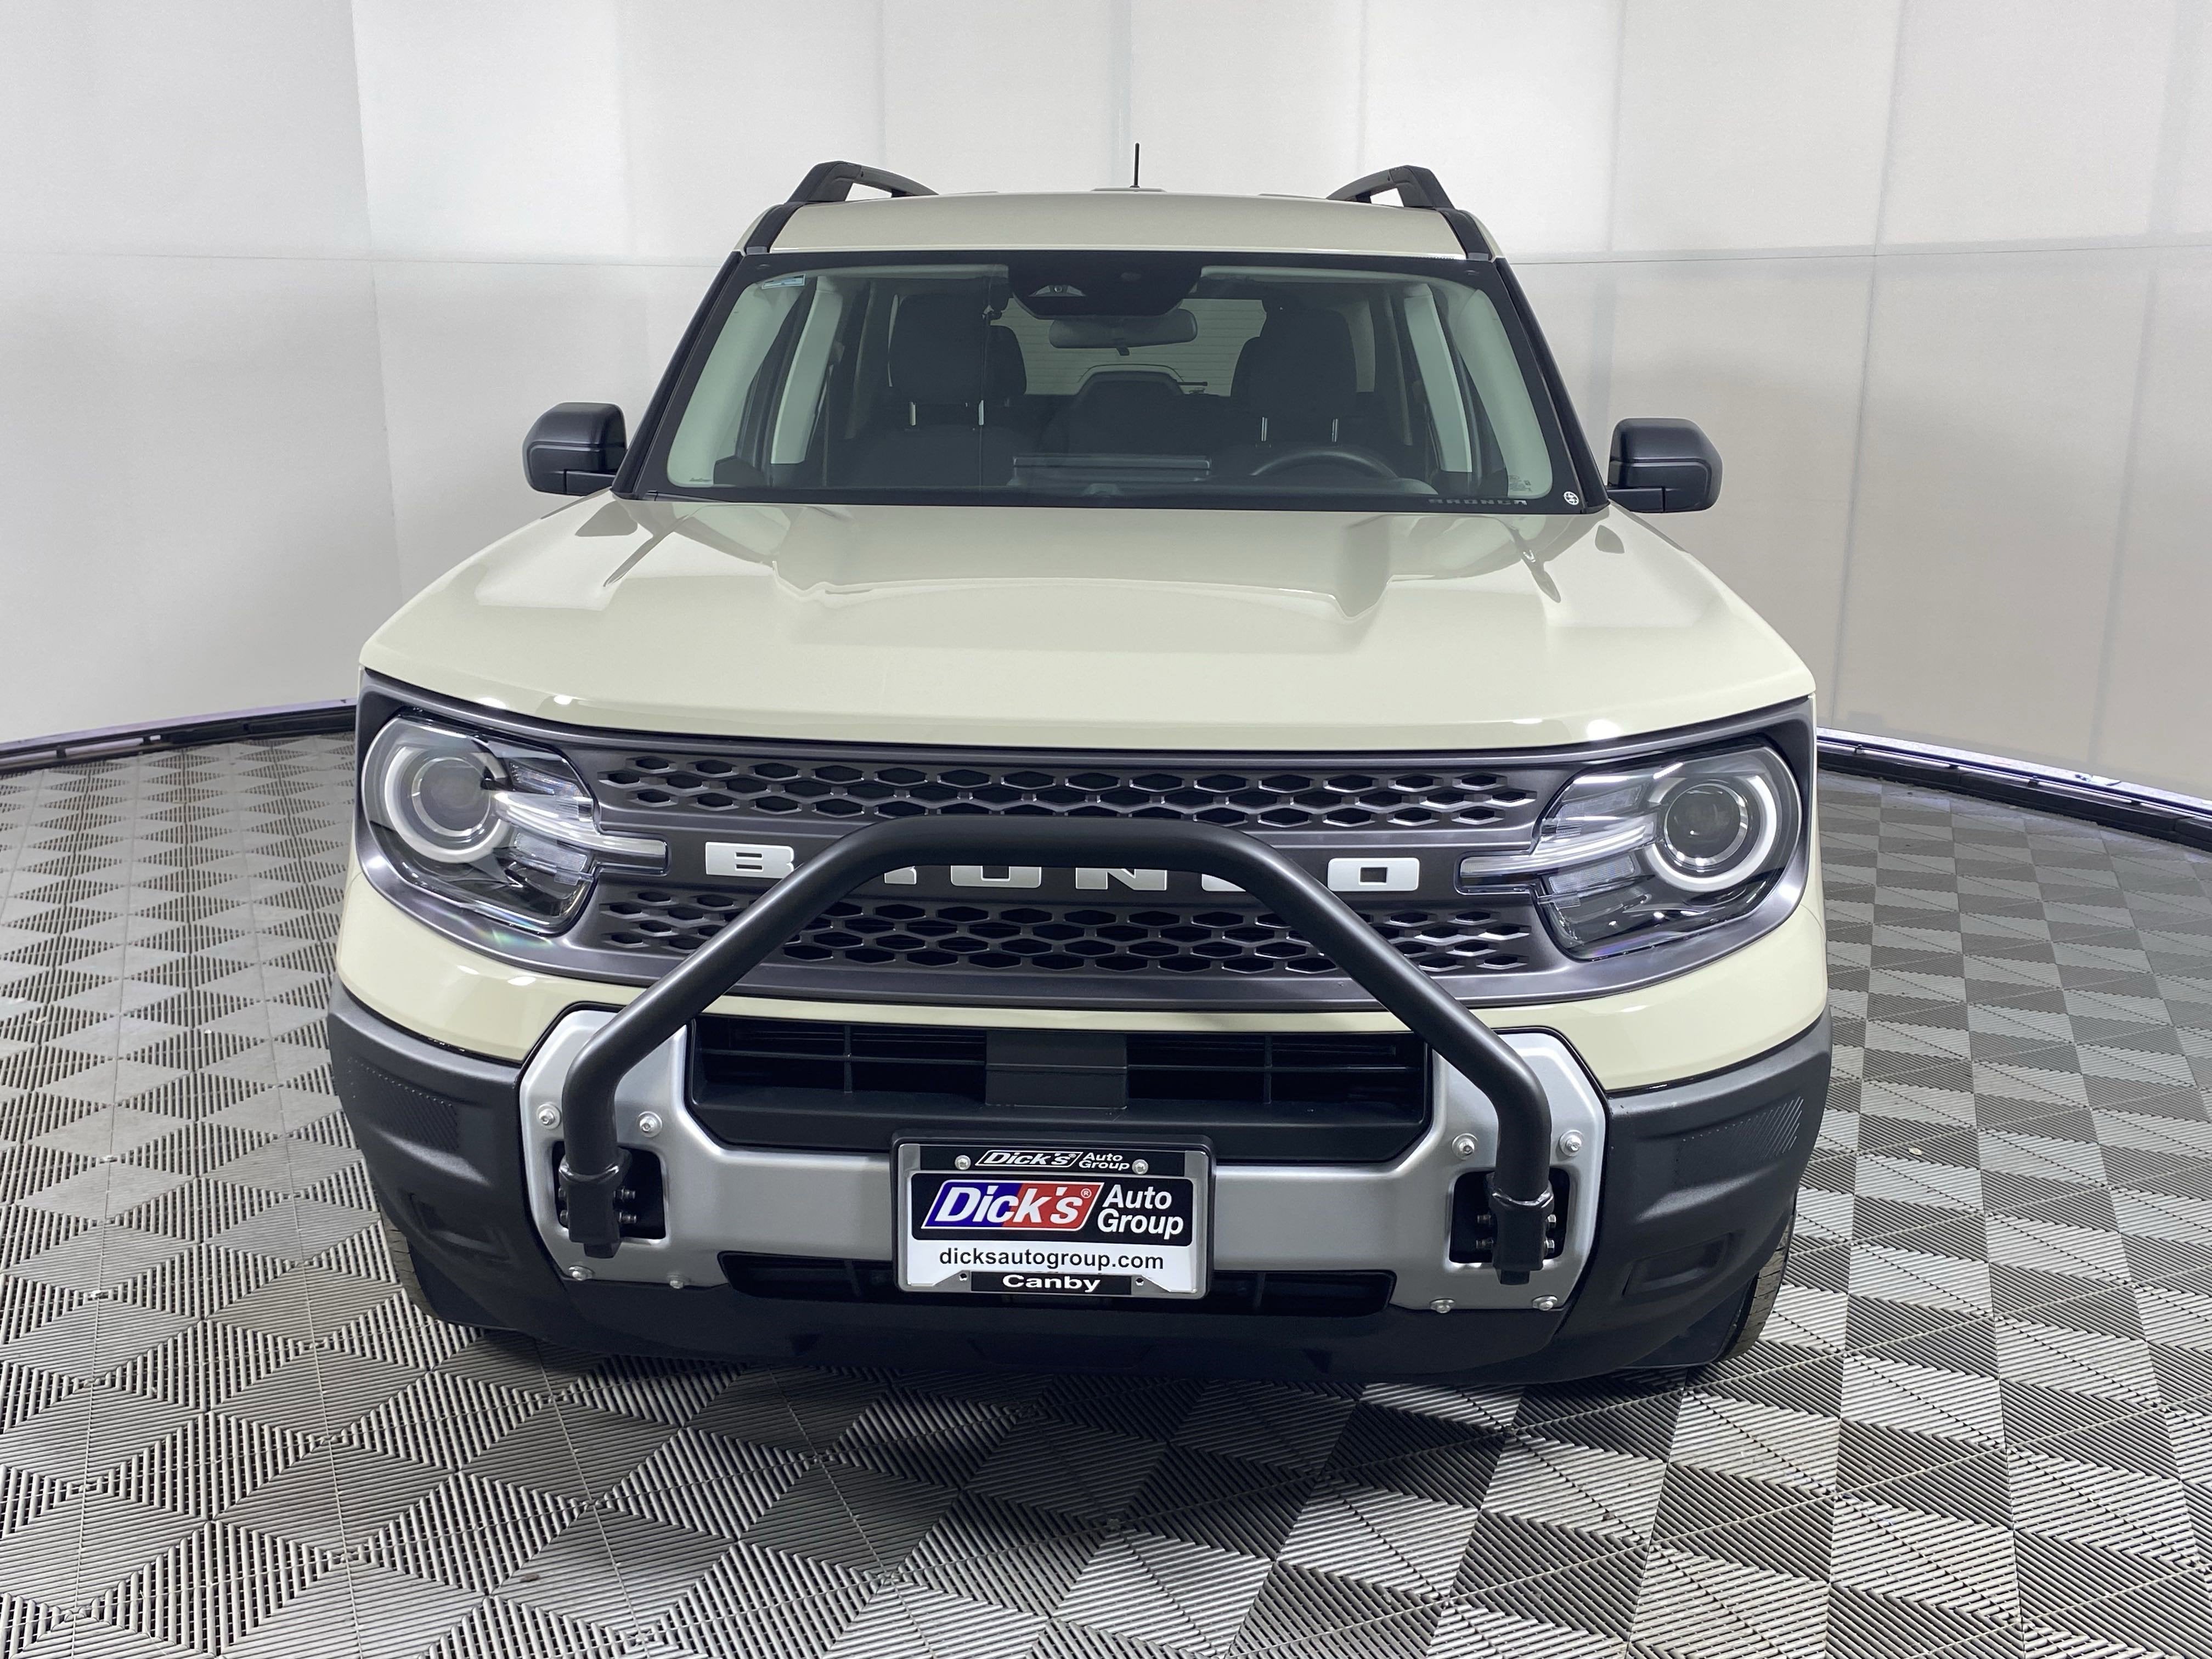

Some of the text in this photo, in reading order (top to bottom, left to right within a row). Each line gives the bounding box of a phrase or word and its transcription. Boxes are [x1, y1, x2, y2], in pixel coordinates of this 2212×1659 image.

[706, 842, 1419, 892] BONO
[1079, 1160, 1130, 1171] Group
[1082, 1153, 1123, 1161] Auto
[1102, 1184, 1172, 1210] Auto
[1097, 1209, 1183, 1240] Group
[939, 1248, 1163, 1271] dicksautogroup.com
[1002, 1274, 1101, 1292] Canby
